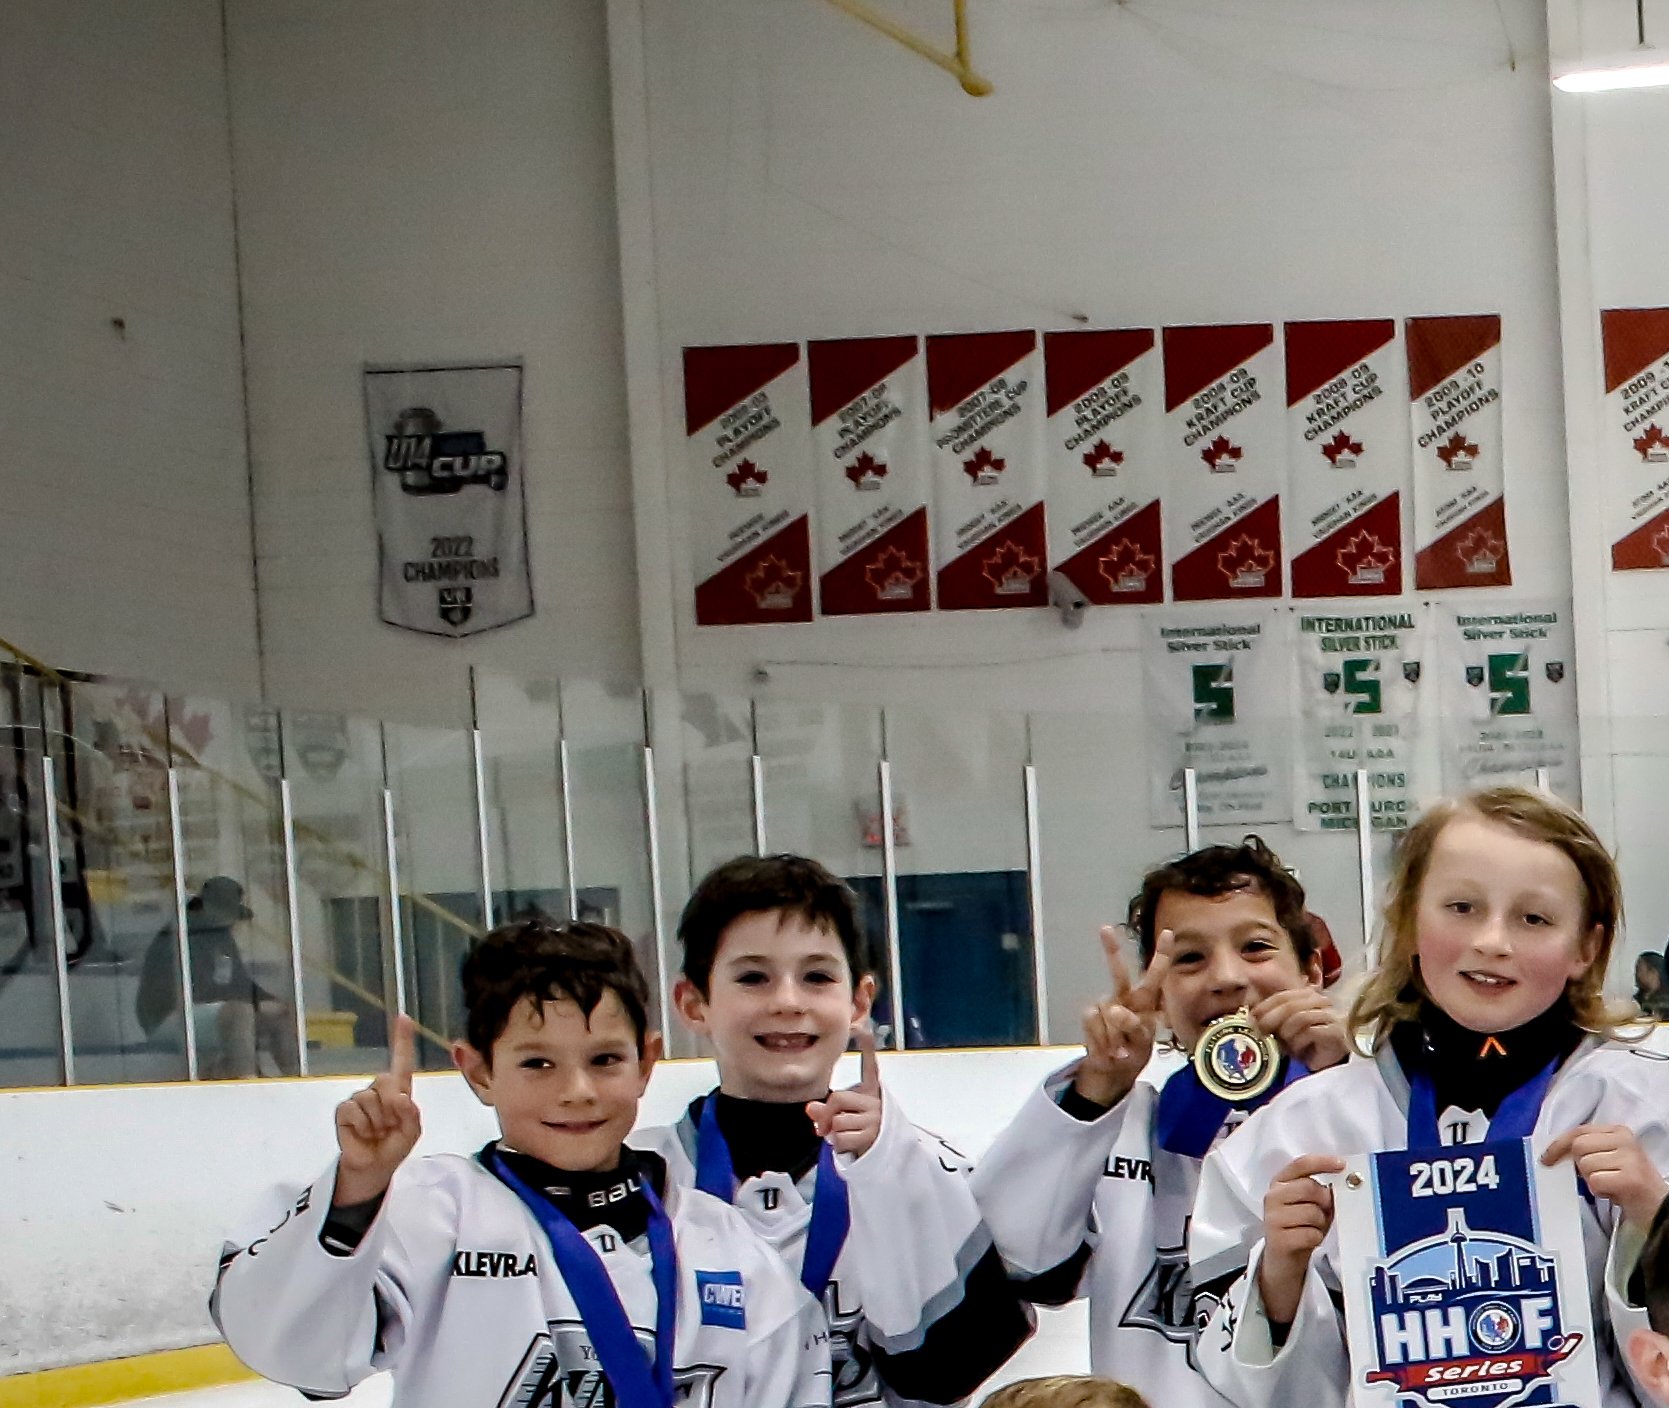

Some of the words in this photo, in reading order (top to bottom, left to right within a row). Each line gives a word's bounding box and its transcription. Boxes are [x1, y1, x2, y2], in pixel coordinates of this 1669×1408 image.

[1183, 391, 1262, 447] CHAMPIONS
[1185, 397, 1226, 430] KRAFT
[1303, 386, 1384, 442] CHAMPIONS
[1305, 391, 1348, 426] KRAFT
[1353, 372, 1379, 396] CUP
[1417, 388, 1499, 448] CHAMPIONS
[1430, 381, 1483, 421] PLAYOFF
[1065, 394, 1142, 451] CHAMPIONS
[432, 454, 504, 478] CUP
[404, 557, 500, 582] CHAMPIONS
[1301, 613, 1416, 633] INTERNATIONAL
[1409, 1154, 1501, 1198] 2024
[1442, 1382, 1509, 1396] TORONTO
